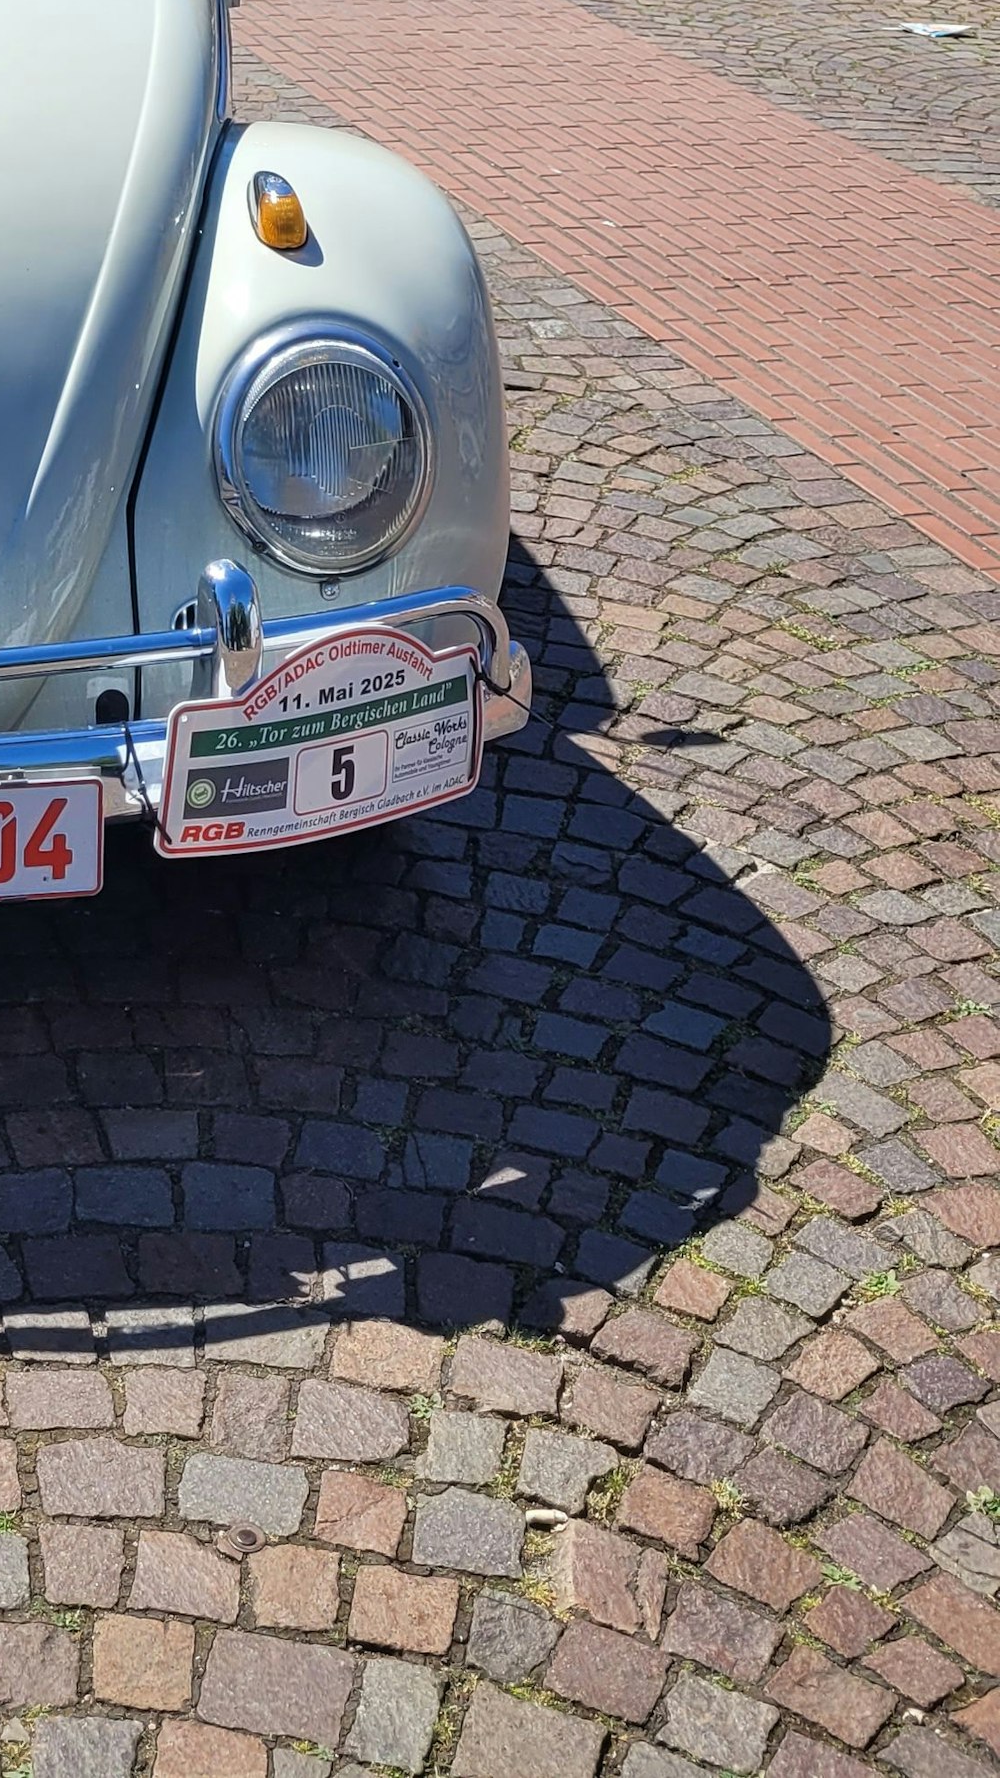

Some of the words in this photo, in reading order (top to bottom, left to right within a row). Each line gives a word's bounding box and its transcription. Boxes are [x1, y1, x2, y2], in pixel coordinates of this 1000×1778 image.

[328, 640, 386, 661] Oldtimer
[386, 642, 433, 681] Ausfahrt
[279, 693, 310, 712] 11.
[318, 682, 354, 705] Mai
[360, 669, 405, 695] 2025
[215, 731, 242, 750] 26.
[291, 720, 325, 739] zum
[330, 698, 407, 730] Bergischen
[395, 729, 431, 750] Classic
[434, 716, 467, 736] Works
[429, 734, 468, 754] Cologne
[220, 776, 287, 802] Hiltscher
[331, 745, 355, 801] 5
[180, 822, 246, 843] RGB
[247, 811, 337, 838] Renngemeinschaft
[339, 800, 375, 820] Bergisch
[377, 790, 415, 810] Gladbach
[416, 785, 429, 798] e.V.
[432, 783, 441, 793] im
[443, 773, 466, 789] ADAC
